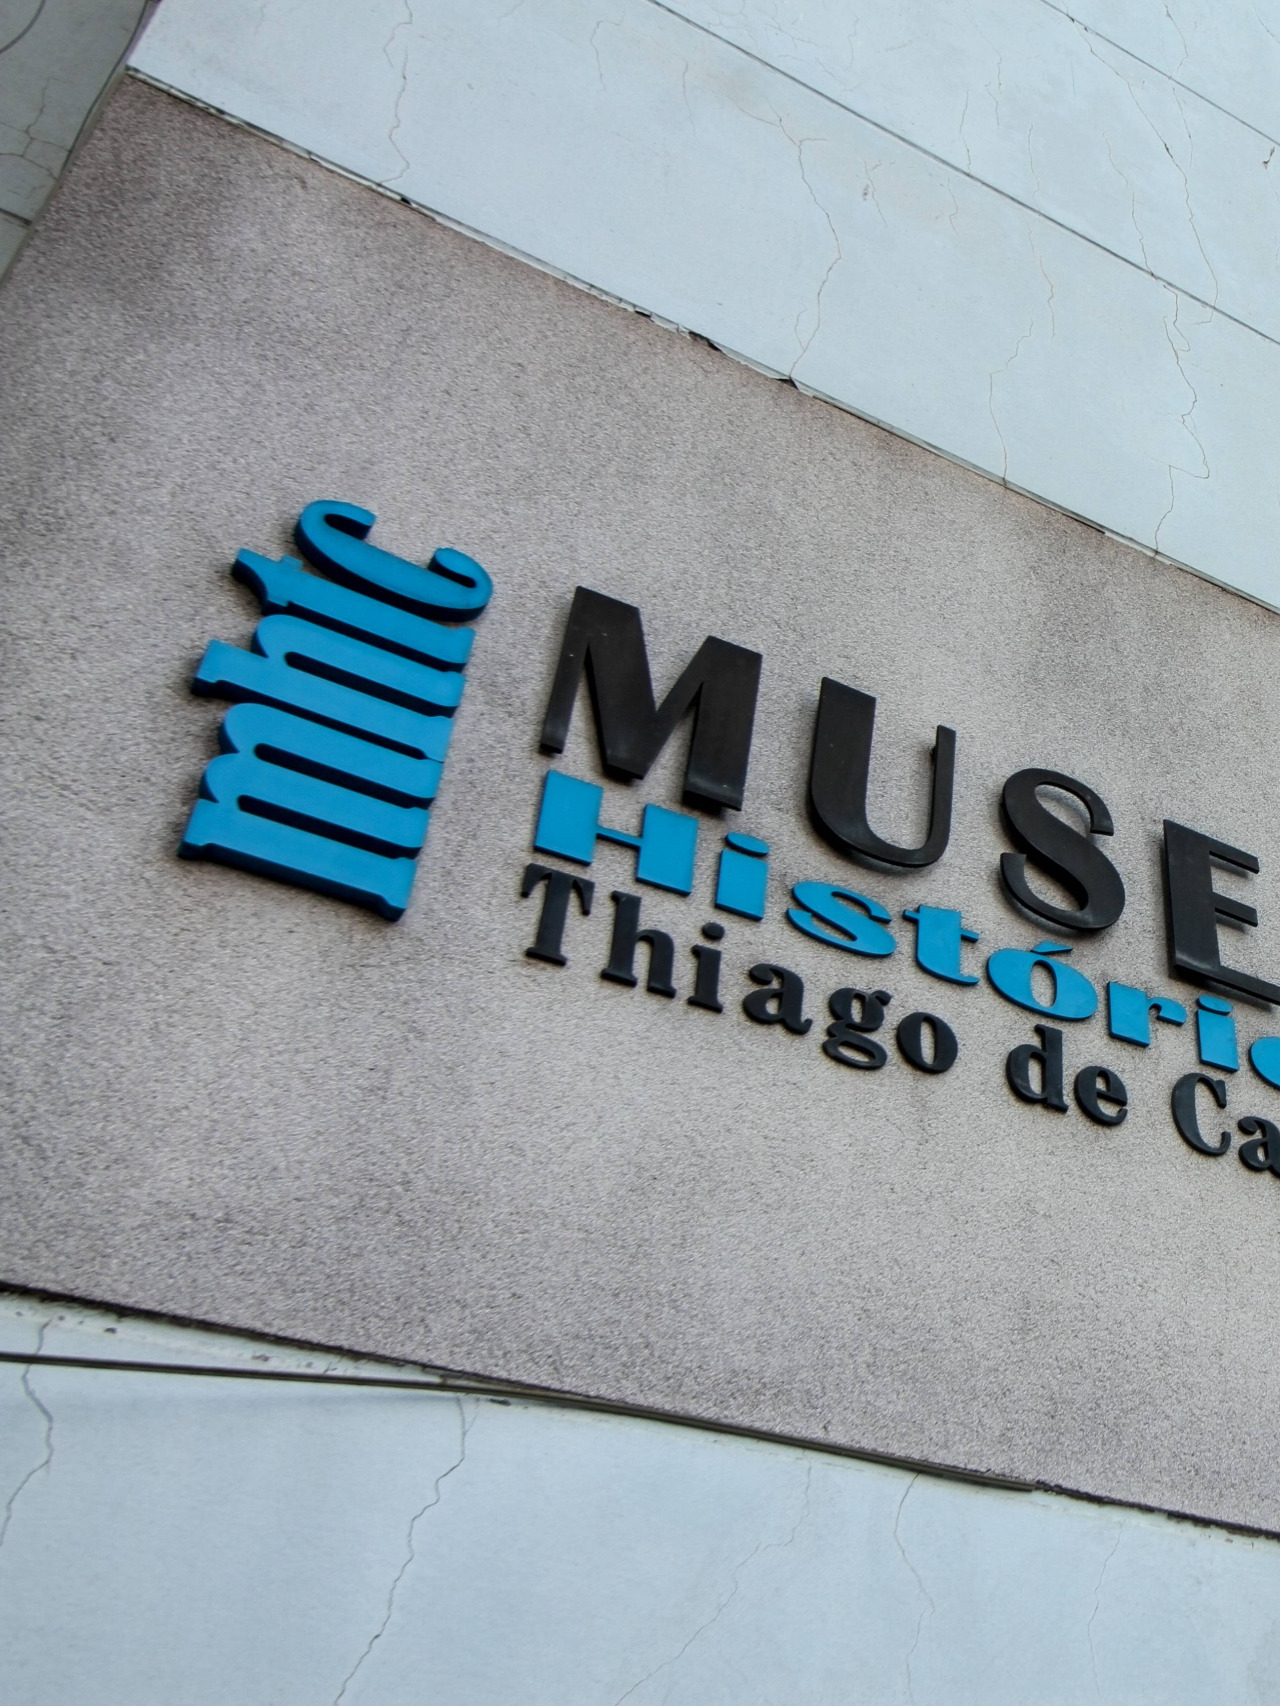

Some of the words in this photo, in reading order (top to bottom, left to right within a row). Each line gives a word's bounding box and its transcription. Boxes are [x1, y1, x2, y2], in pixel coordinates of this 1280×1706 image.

[177, 500, 493, 922] mhtc
[520, 862, 959, 1074] Thiago
[1006, 1023, 1128, 1127] de
